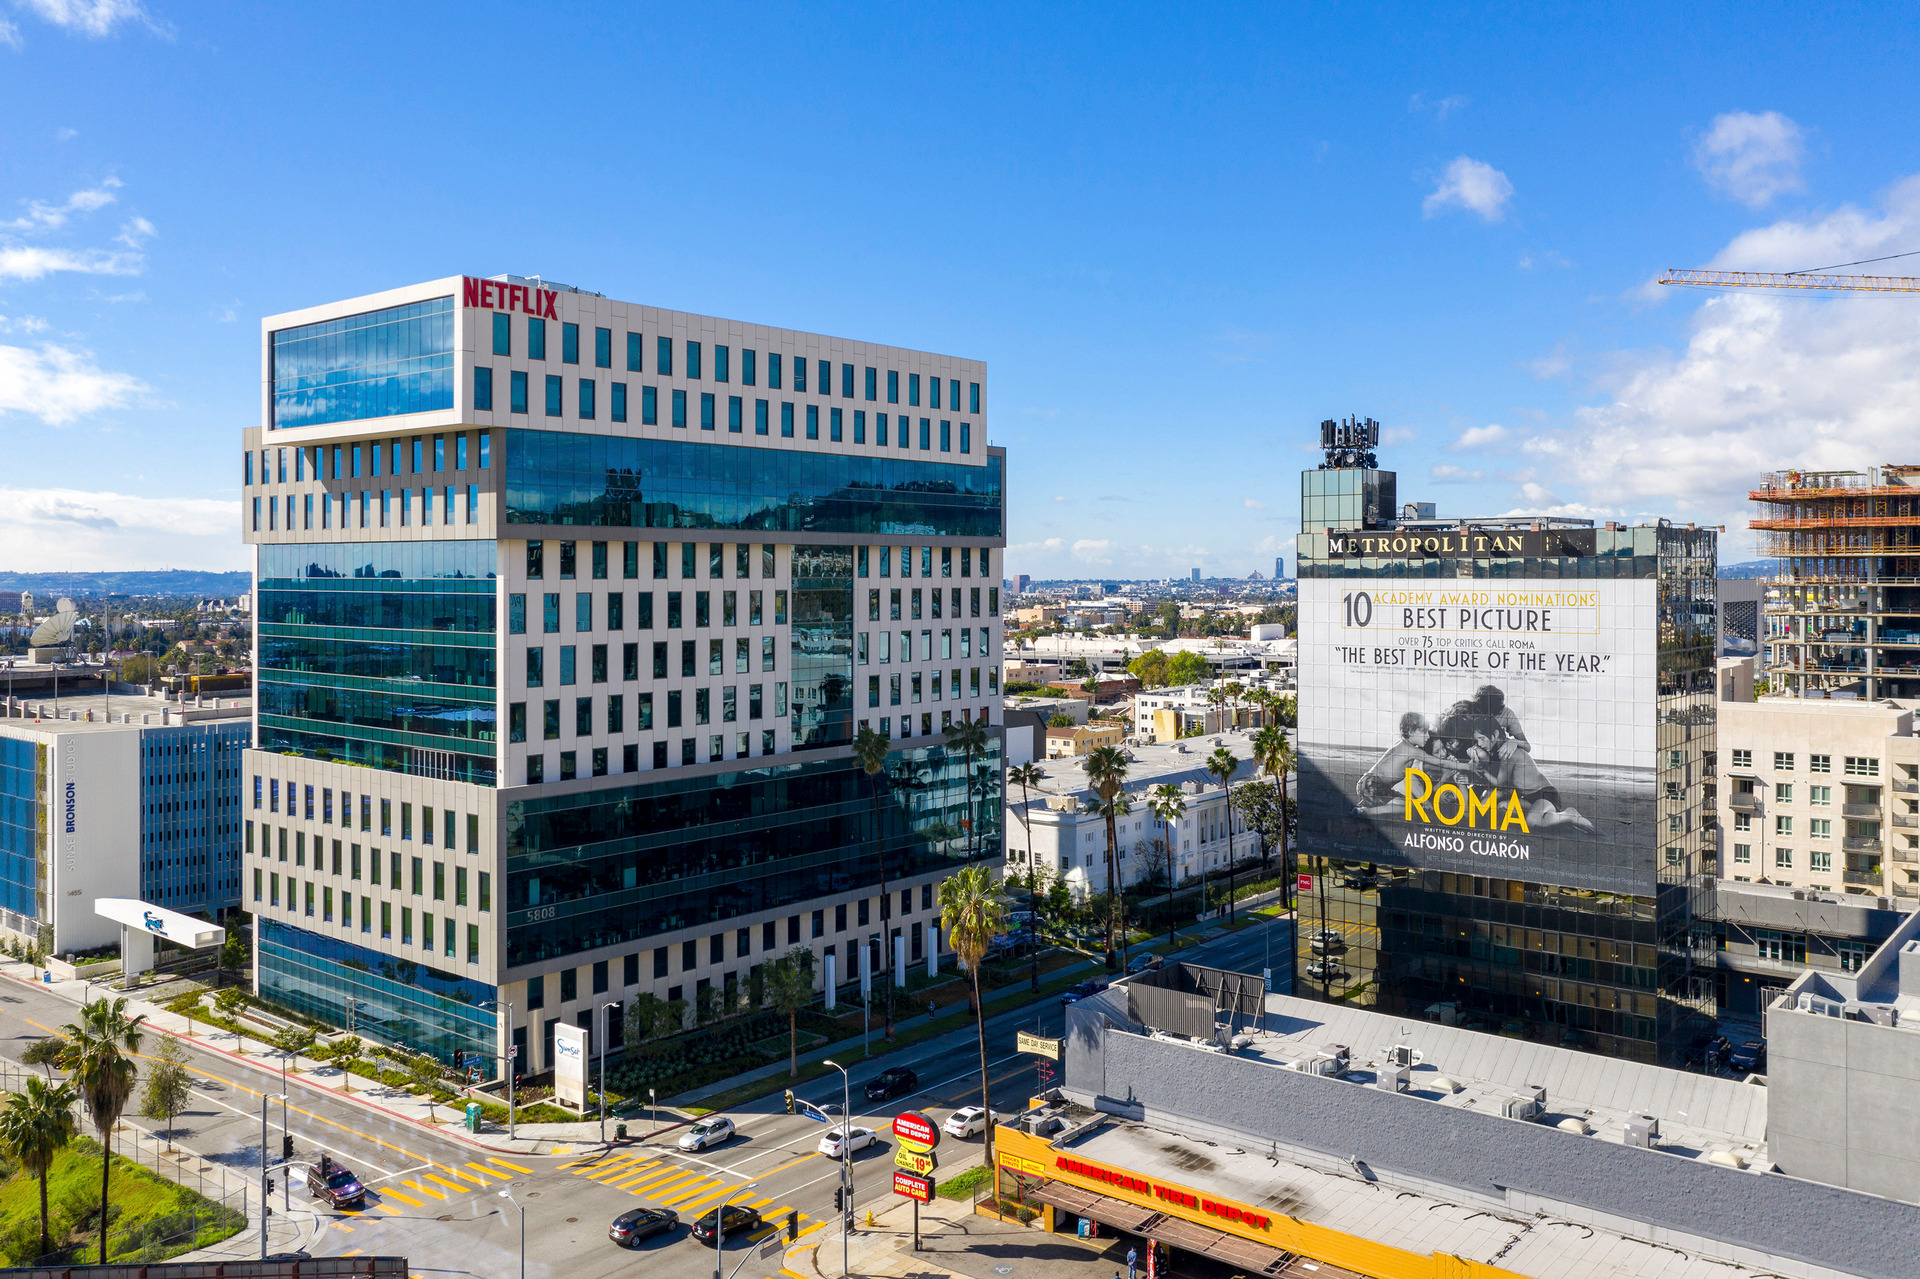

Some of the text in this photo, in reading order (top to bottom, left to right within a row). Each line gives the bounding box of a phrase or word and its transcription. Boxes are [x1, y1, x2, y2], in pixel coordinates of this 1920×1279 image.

[463, 276, 558, 321] NETFLIX
[1329, 535, 1523, 553] METROPOLITAN
[1373, 592, 1596, 607] ACADEMY AWARD NOMINATIONS
[1343, 591, 1372, 628] 10
[1403, 608, 1551, 631] BEST PICTURE
[1398, 635, 1535, 649] OVER 75 TOP CRITICS CALL ROMA
[1374, 647, 1406, 665] BEST
[1414, 649, 1479, 668] PICTURE
[1488, 651, 1510, 669] OF
[1518, 652, 1546, 671] THE
[66, 738, 75, 783] STUDIOS
[66, 782, 75, 833] BRONSON
[1405, 767, 1530, 834] ROMA
[1467, 831, 1496, 839] DIRECTED
[1404, 832, 1529, 860] ALFONSO CUARÓN
[527, 906, 555, 922] 5808
[1018, 1036, 1057, 1052] SAME DAY SERVICE
[896, 1118, 930, 1134] AMERICAN
[896, 1125, 930, 1140] TIRE DEPOT
[896, 1158, 915, 1170] CHANGE
[898, 1152, 907, 1161] OIL
[894, 1183, 927, 1198] AUTO CARE
[895, 1176, 926, 1191] COMPLETE
[1056, 1156, 1269, 1230] AMERICAN TIRE DEPOT
